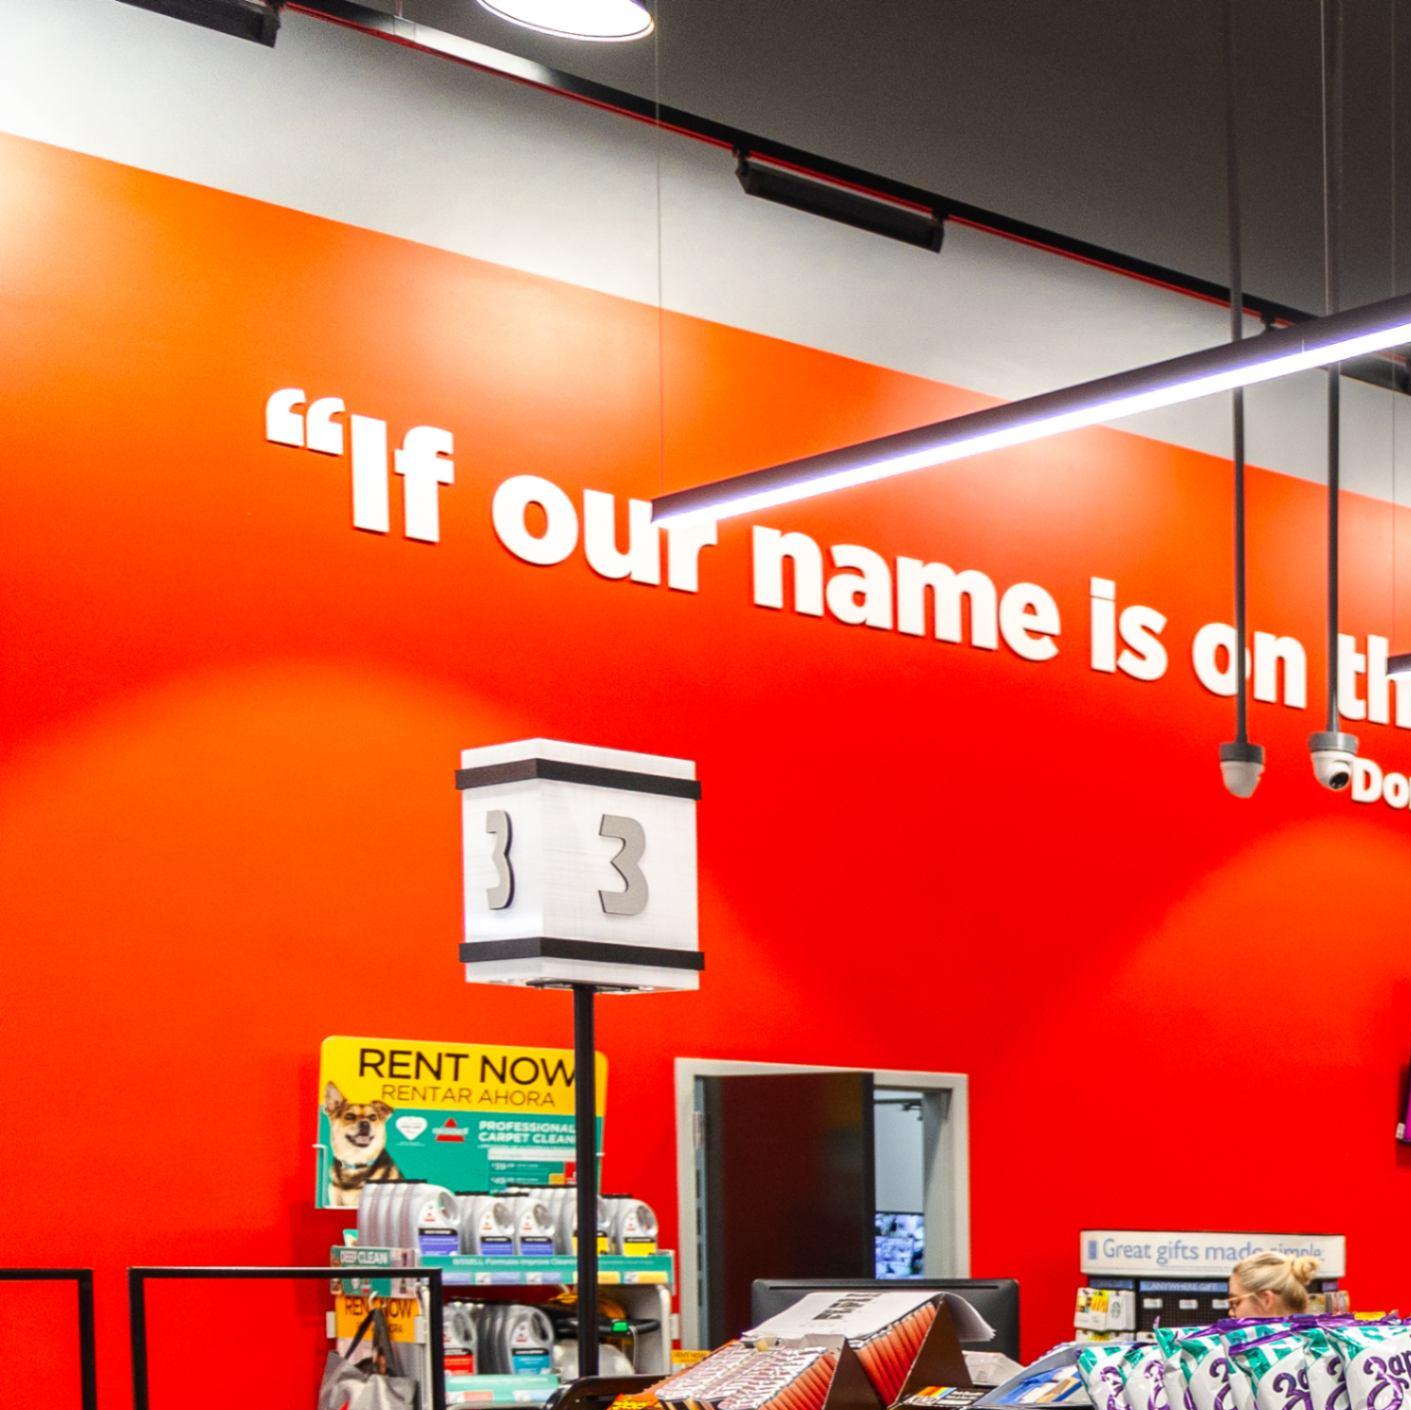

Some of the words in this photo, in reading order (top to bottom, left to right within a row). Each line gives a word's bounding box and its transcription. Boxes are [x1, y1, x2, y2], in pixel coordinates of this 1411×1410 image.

[491, 475, 717, 593] our
[753, 524, 1060, 662] name
[1088, 578, 1167, 682] is
[1192, 622, 1306, 709] on
[598, 814, 651, 917] 3
[359, 1048, 469, 1082] RENT
[480, 1055, 576, 1087] NOW
[381, 1085, 471, 1104] RENTAR
[479, 1089, 556, 1107] AHORA
[478, 1120, 577, 1134] PROFESSIONAL
[478, 1132, 529, 1144] CARPET
[1102, 1238, 1151, 1259] Great
[1156, 1240, 1199, 1264] gifts
